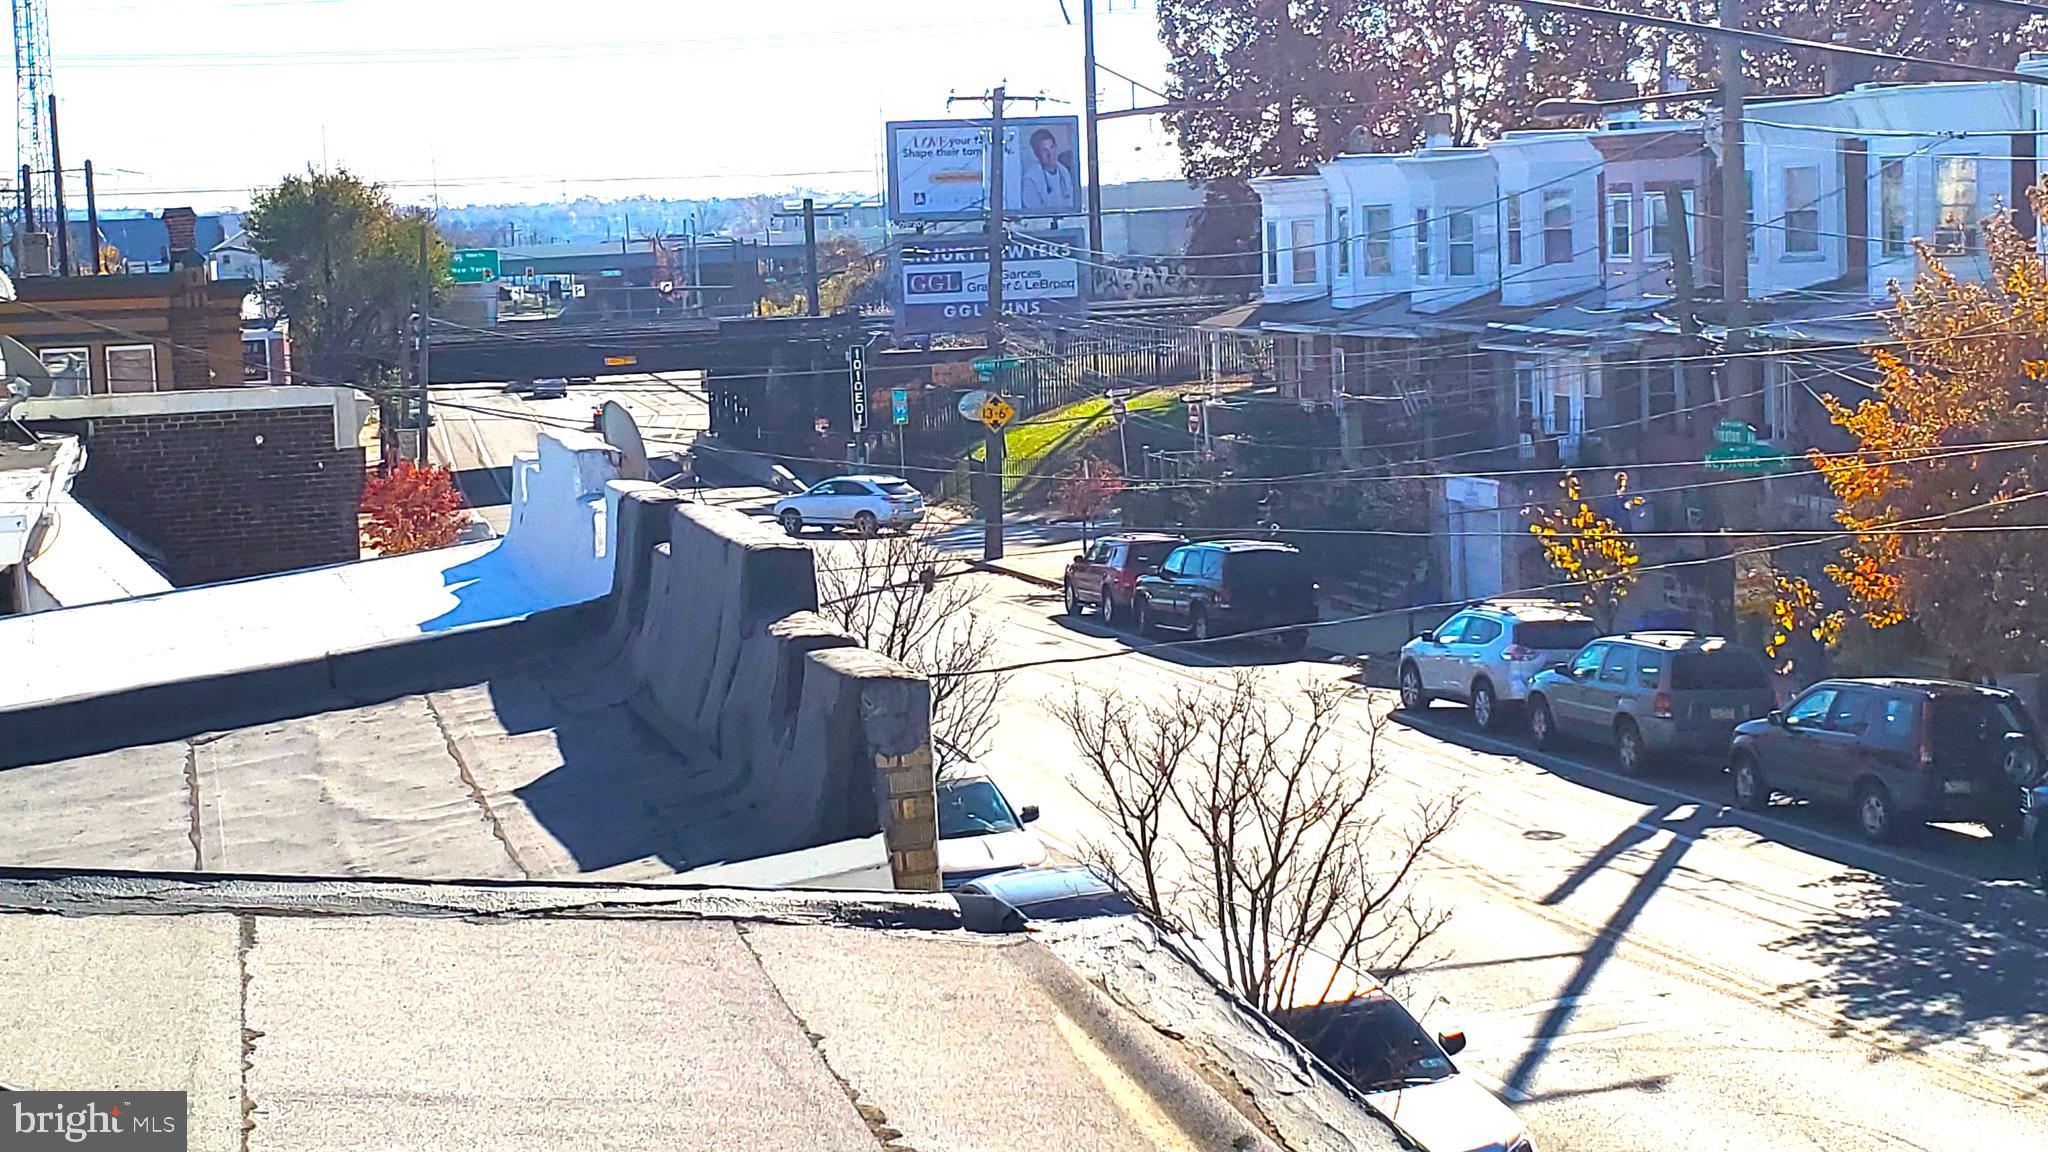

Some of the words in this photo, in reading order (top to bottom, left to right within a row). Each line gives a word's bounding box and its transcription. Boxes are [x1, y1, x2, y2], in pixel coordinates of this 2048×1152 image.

[949, 137, 970, 147] your
[903, 148, 933, 159] Shape
[936, 147, 960, 156] their
[910, 274, 960, 292] GGL
